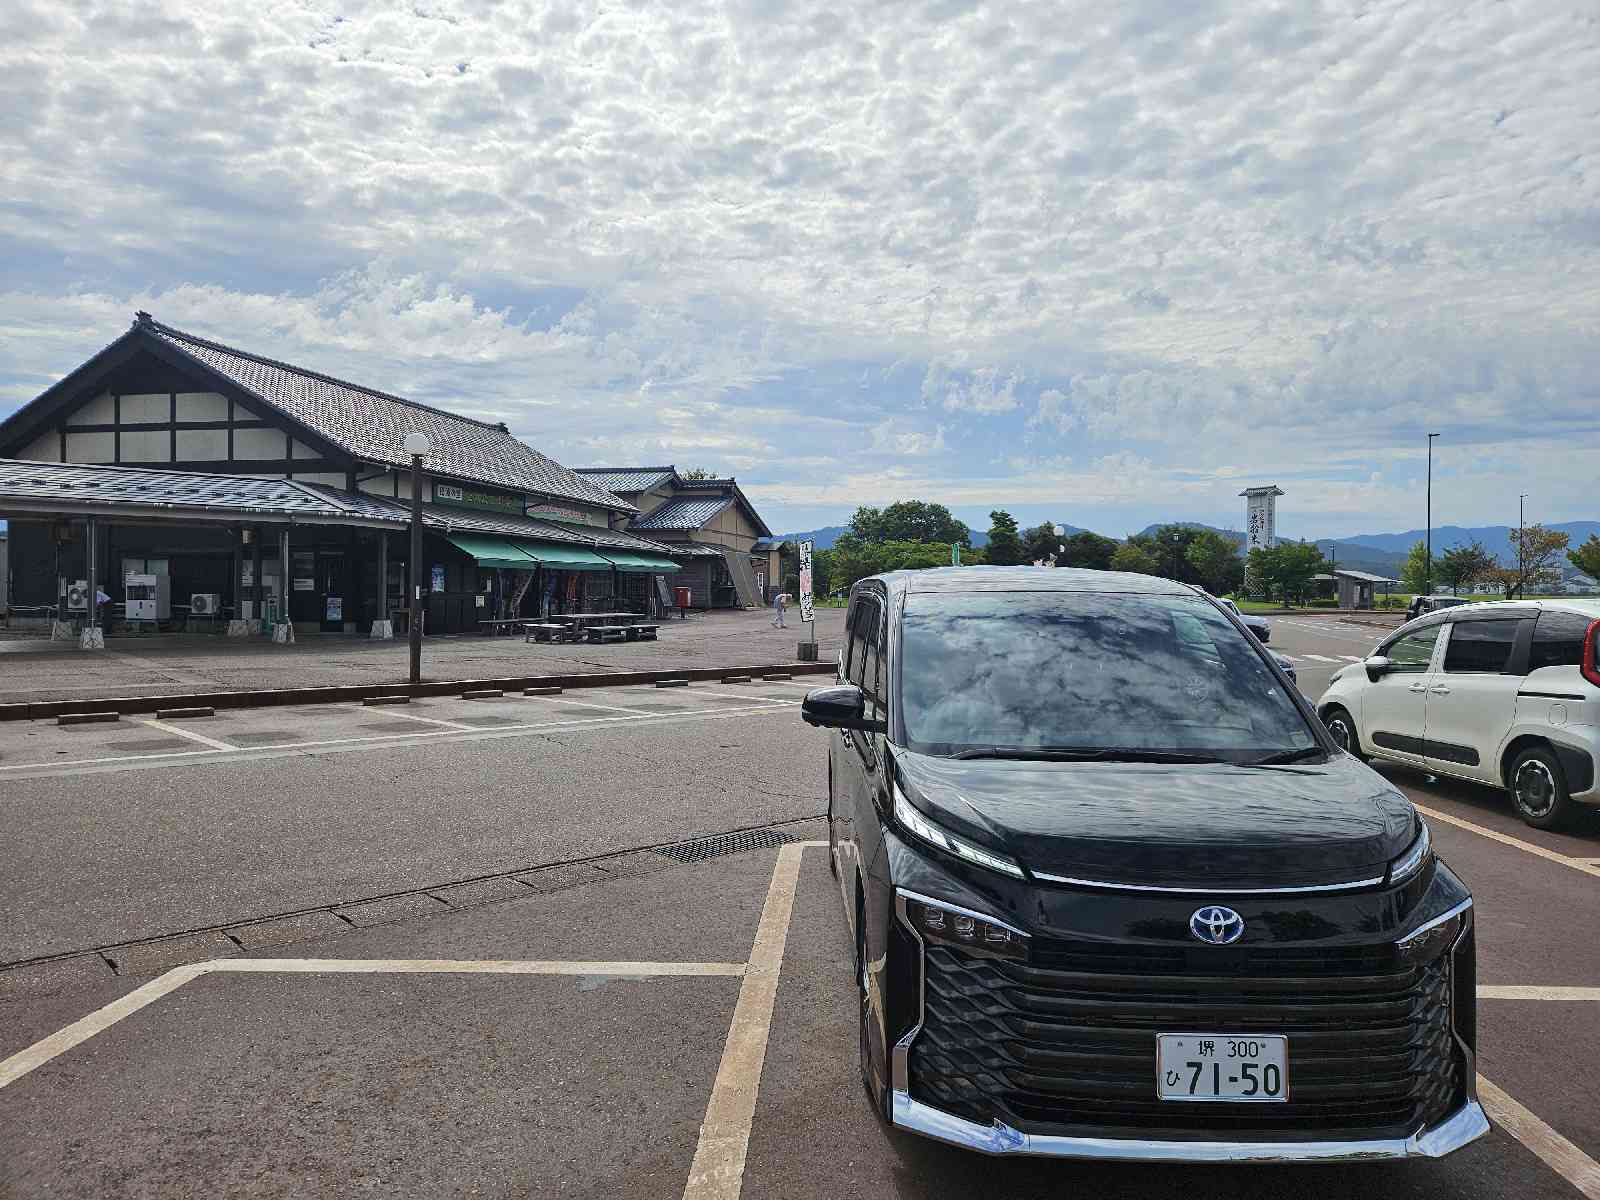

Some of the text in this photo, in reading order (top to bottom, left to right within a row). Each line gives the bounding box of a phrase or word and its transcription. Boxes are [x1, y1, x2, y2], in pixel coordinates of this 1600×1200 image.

[1198, 1040, 1259, 1058] 堺 300
[1166, 1061, 1281, 1096] ひ 71-50
